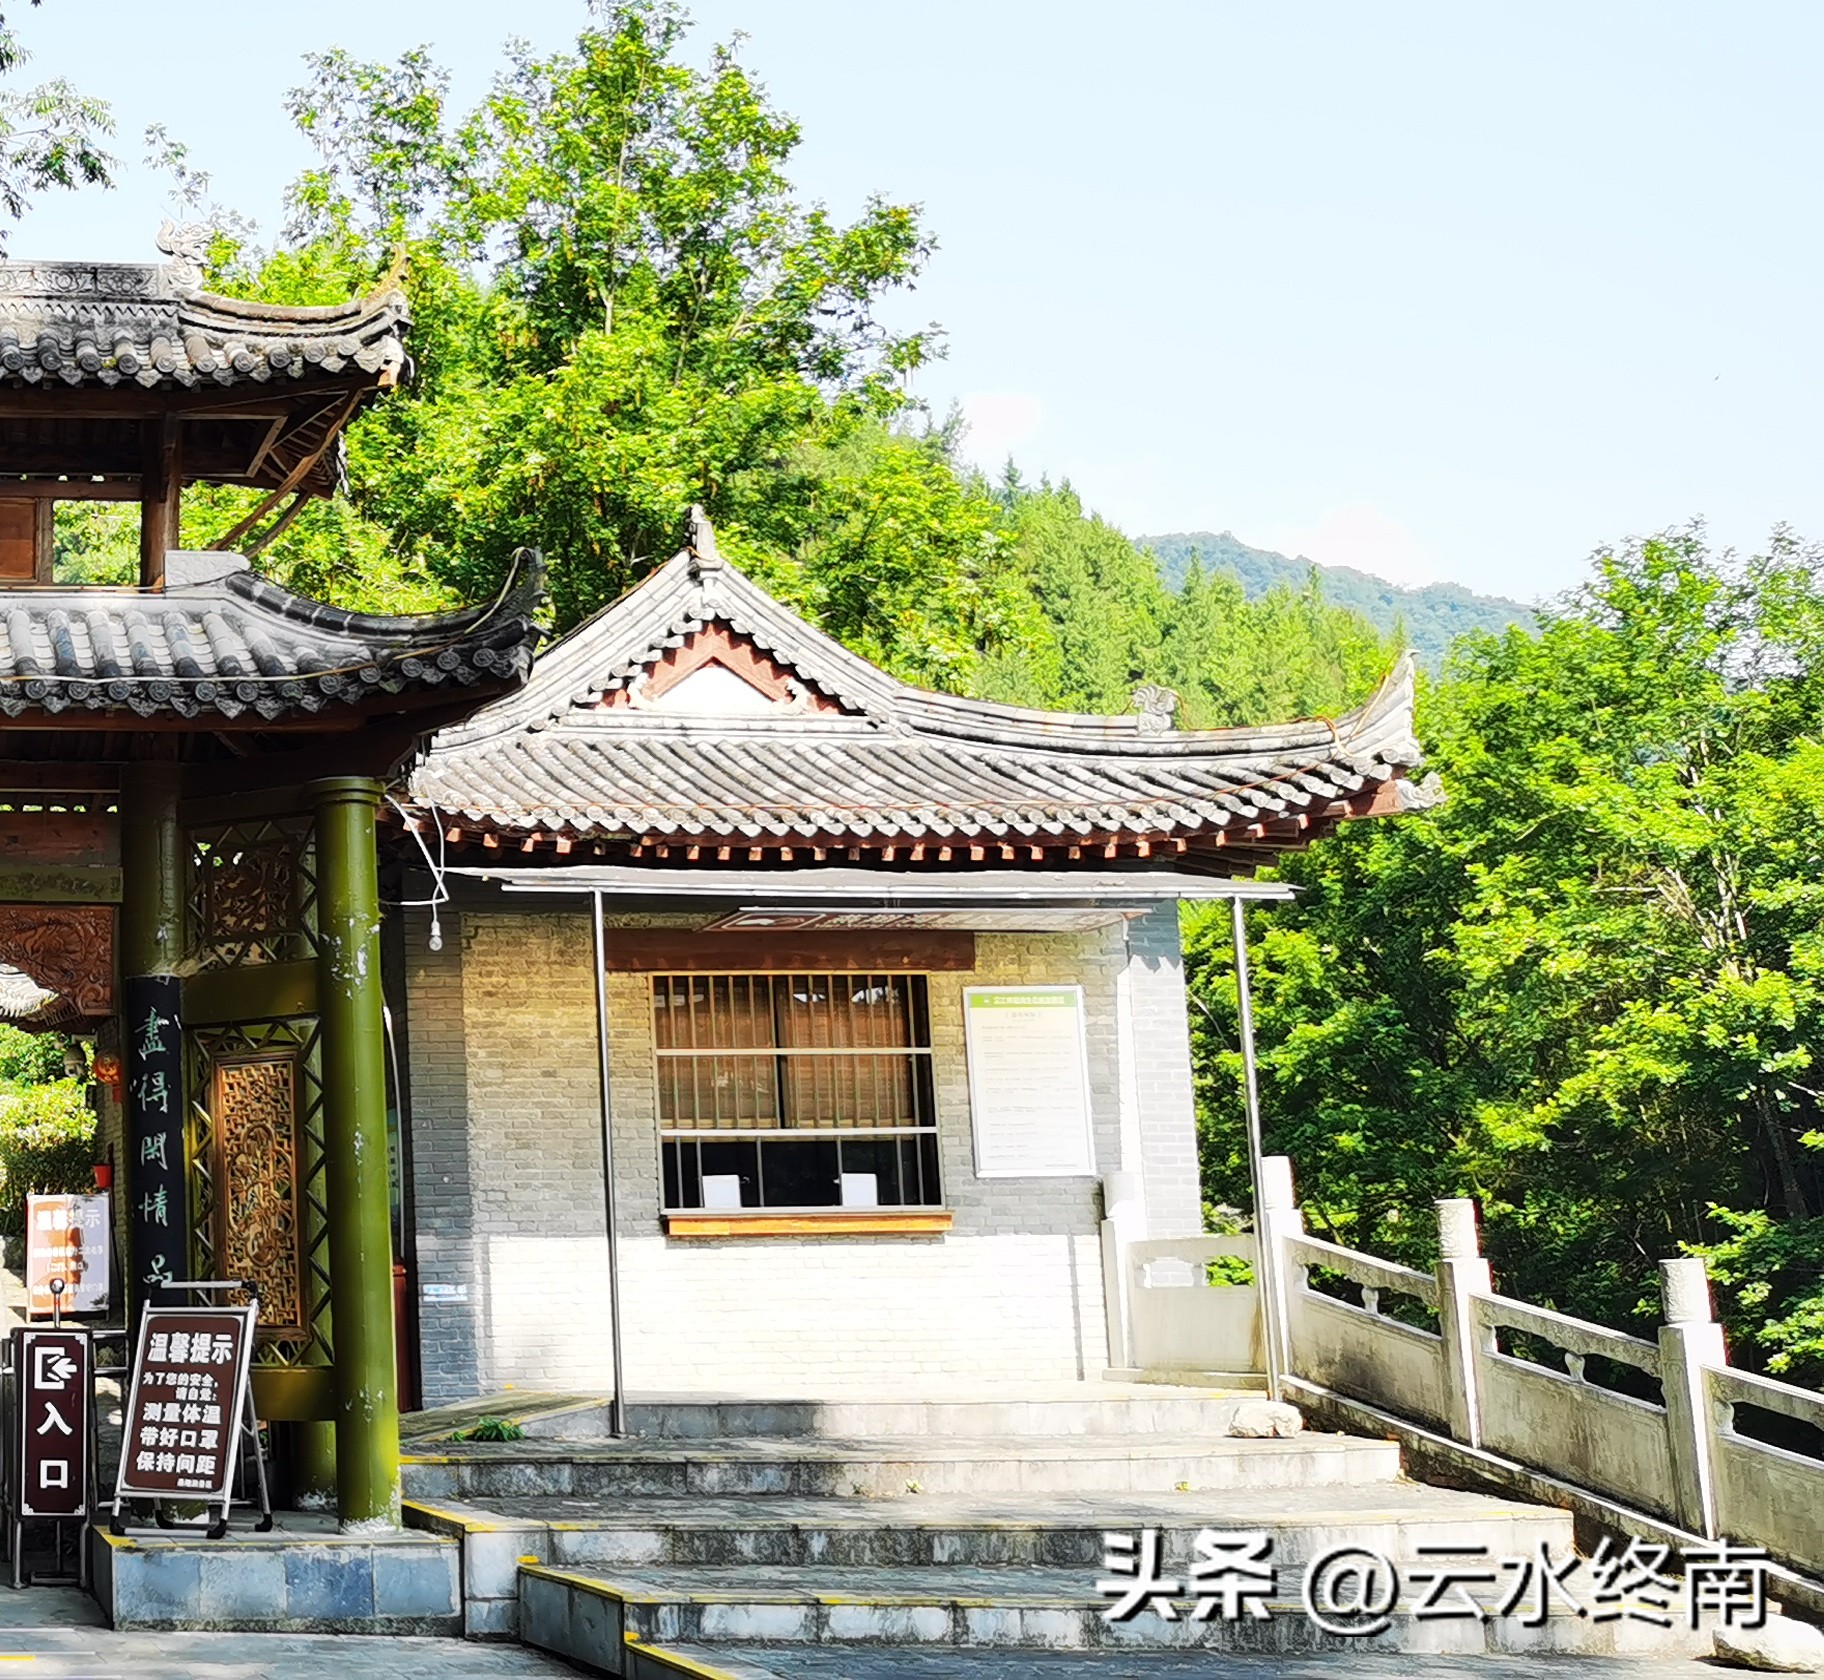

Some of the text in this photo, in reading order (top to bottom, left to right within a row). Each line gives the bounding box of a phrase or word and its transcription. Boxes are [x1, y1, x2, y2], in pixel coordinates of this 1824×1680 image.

[147, 1332, 234, 1364] 温馨提示
[142, 1402, 222, 1425] 测量体温
[36, 1401, 73, 1489] 入口
[139, 1426, 219, 1450] 带好口罩
[136, 1451, 217, 1475] 保持间距
